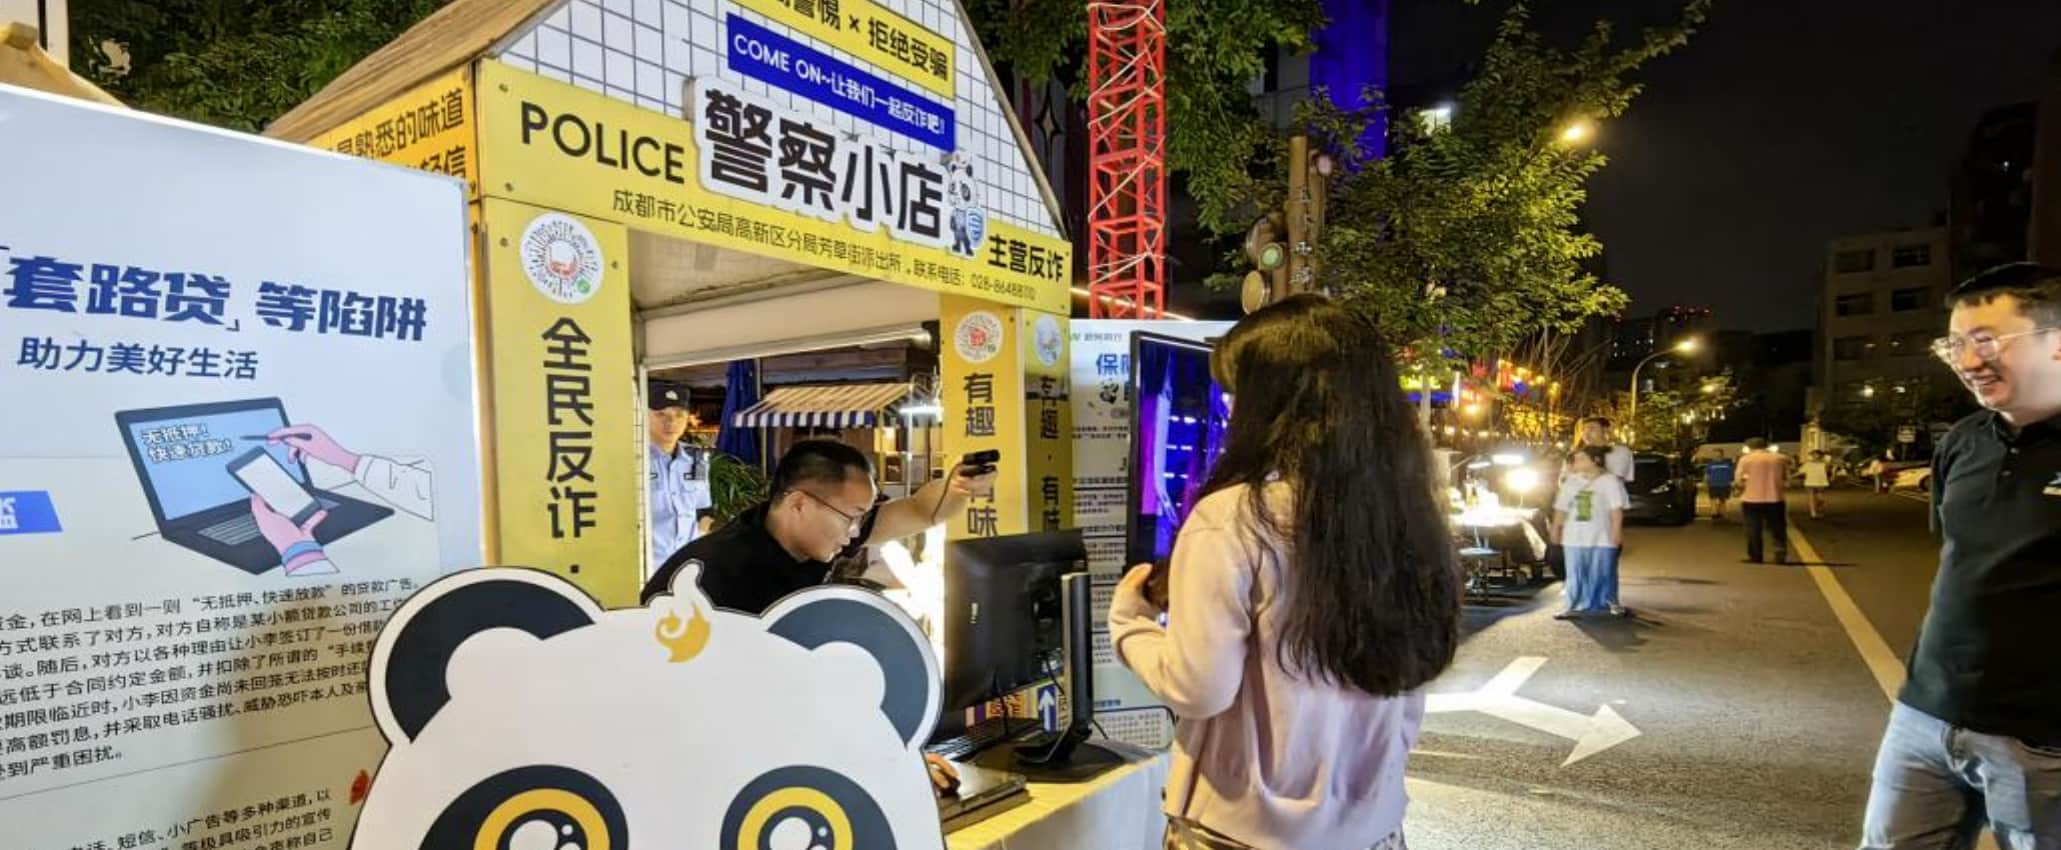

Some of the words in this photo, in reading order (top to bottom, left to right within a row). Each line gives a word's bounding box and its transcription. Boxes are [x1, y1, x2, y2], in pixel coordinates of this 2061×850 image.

[734, 34, 791, 73] COME
[777, 0, 841, 31] 警惕
[868, 16, 949, 81] 拒绝受骗
[520, 101, 686, 185] POLICE
[705, 89, 943, 239] 警察小店
[987, 232, 1064, 282] 主营反诈
[17, 335, 259, 380] 助力美好生活
